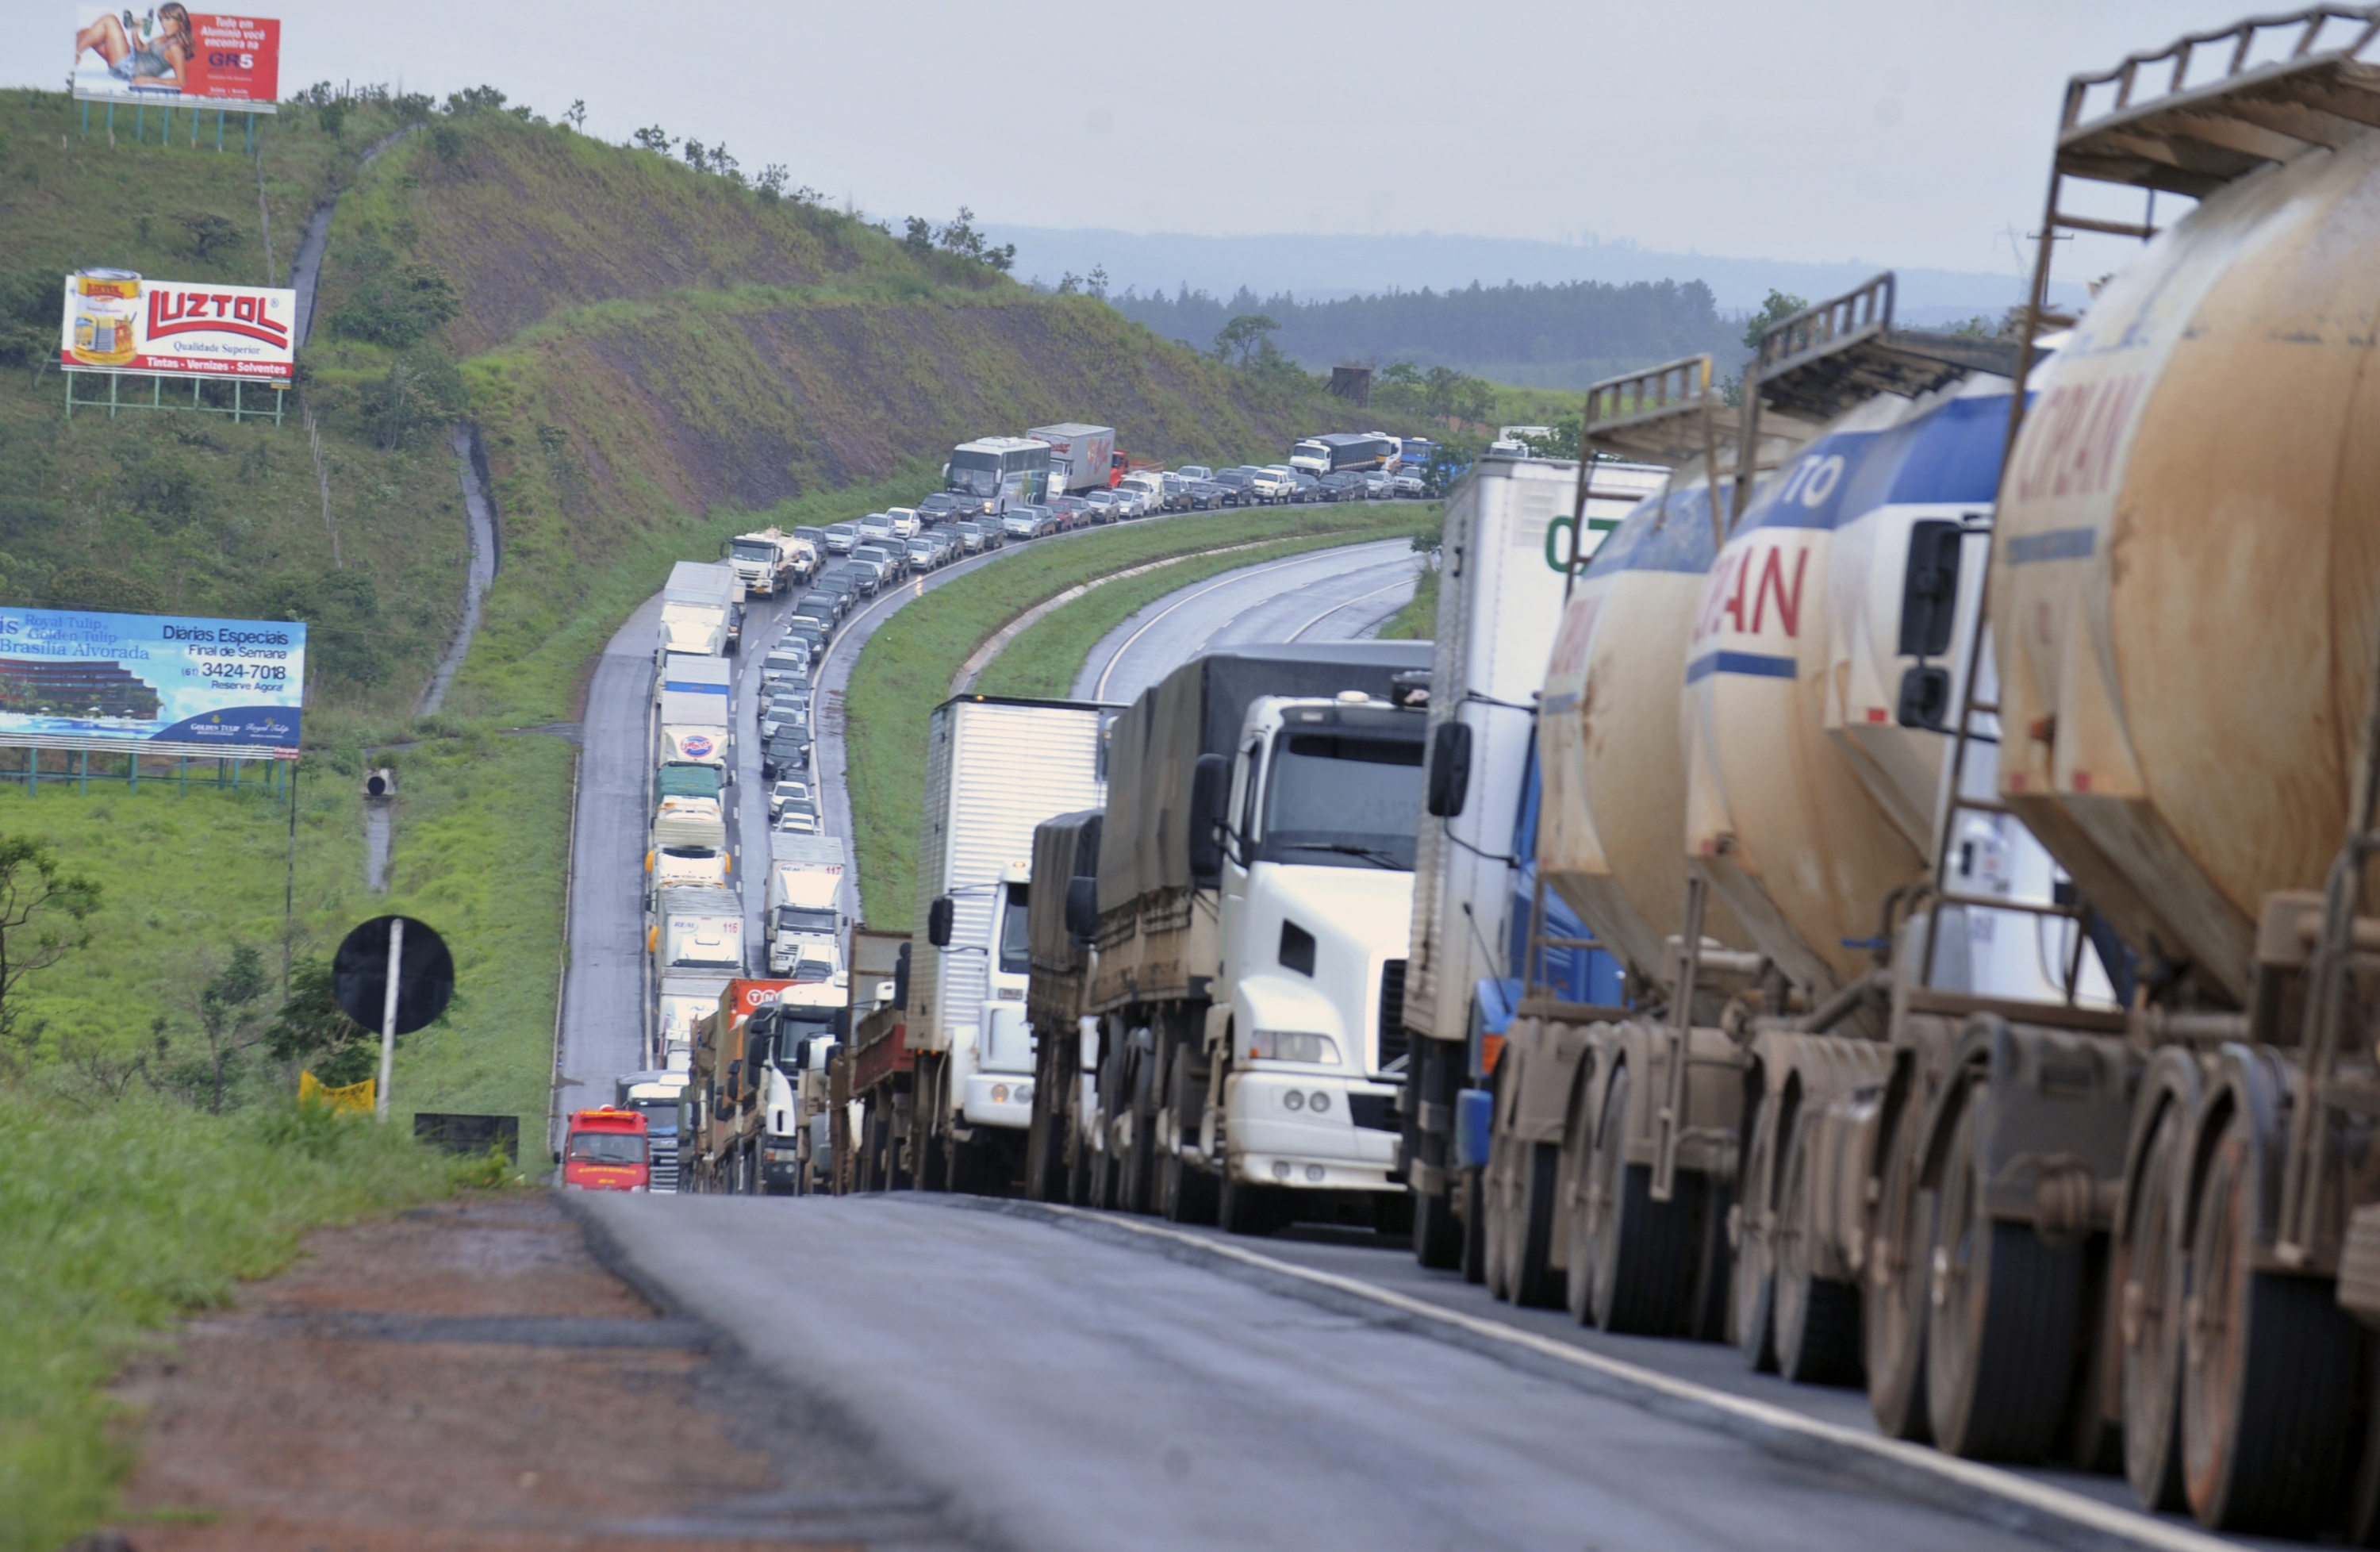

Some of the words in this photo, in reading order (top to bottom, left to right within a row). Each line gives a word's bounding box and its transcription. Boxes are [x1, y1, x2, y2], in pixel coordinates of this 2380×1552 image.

[209, 52, 254, 69] GR5
[147, 290, 287, 349] LUZTOL
[174, 341, 219, 353] Qualidade
[222, 344, 261, 355] Superior
[147, 356, 178, 368] Tintas
[186, 359, 228, 371] Vernizes
[236, 362, 286, 375] Solventes
[25, 613, 63, 630] Royal
[67, 617, 102, 631] Tulip
[28, 628, 78, 642] Golden
[82, 631, 117, 645] Tulip
[219, 628, 289, 647] Especiais
[0, 638, 67, 655] Brasília
[73, 643, 150, 660] Alvorada
[189, 644, 217, 656] Final
[220, 646, 235, 657] de
[238, 646, 287, 659] Semana
[181, 667, 199, 677] (61)
[202, 662, 286, 680] 3424-7018
[211, 680, 251, 690] Reserve
[826, 866, 842, 874] 117
[723, 922, 738, 933] 116
